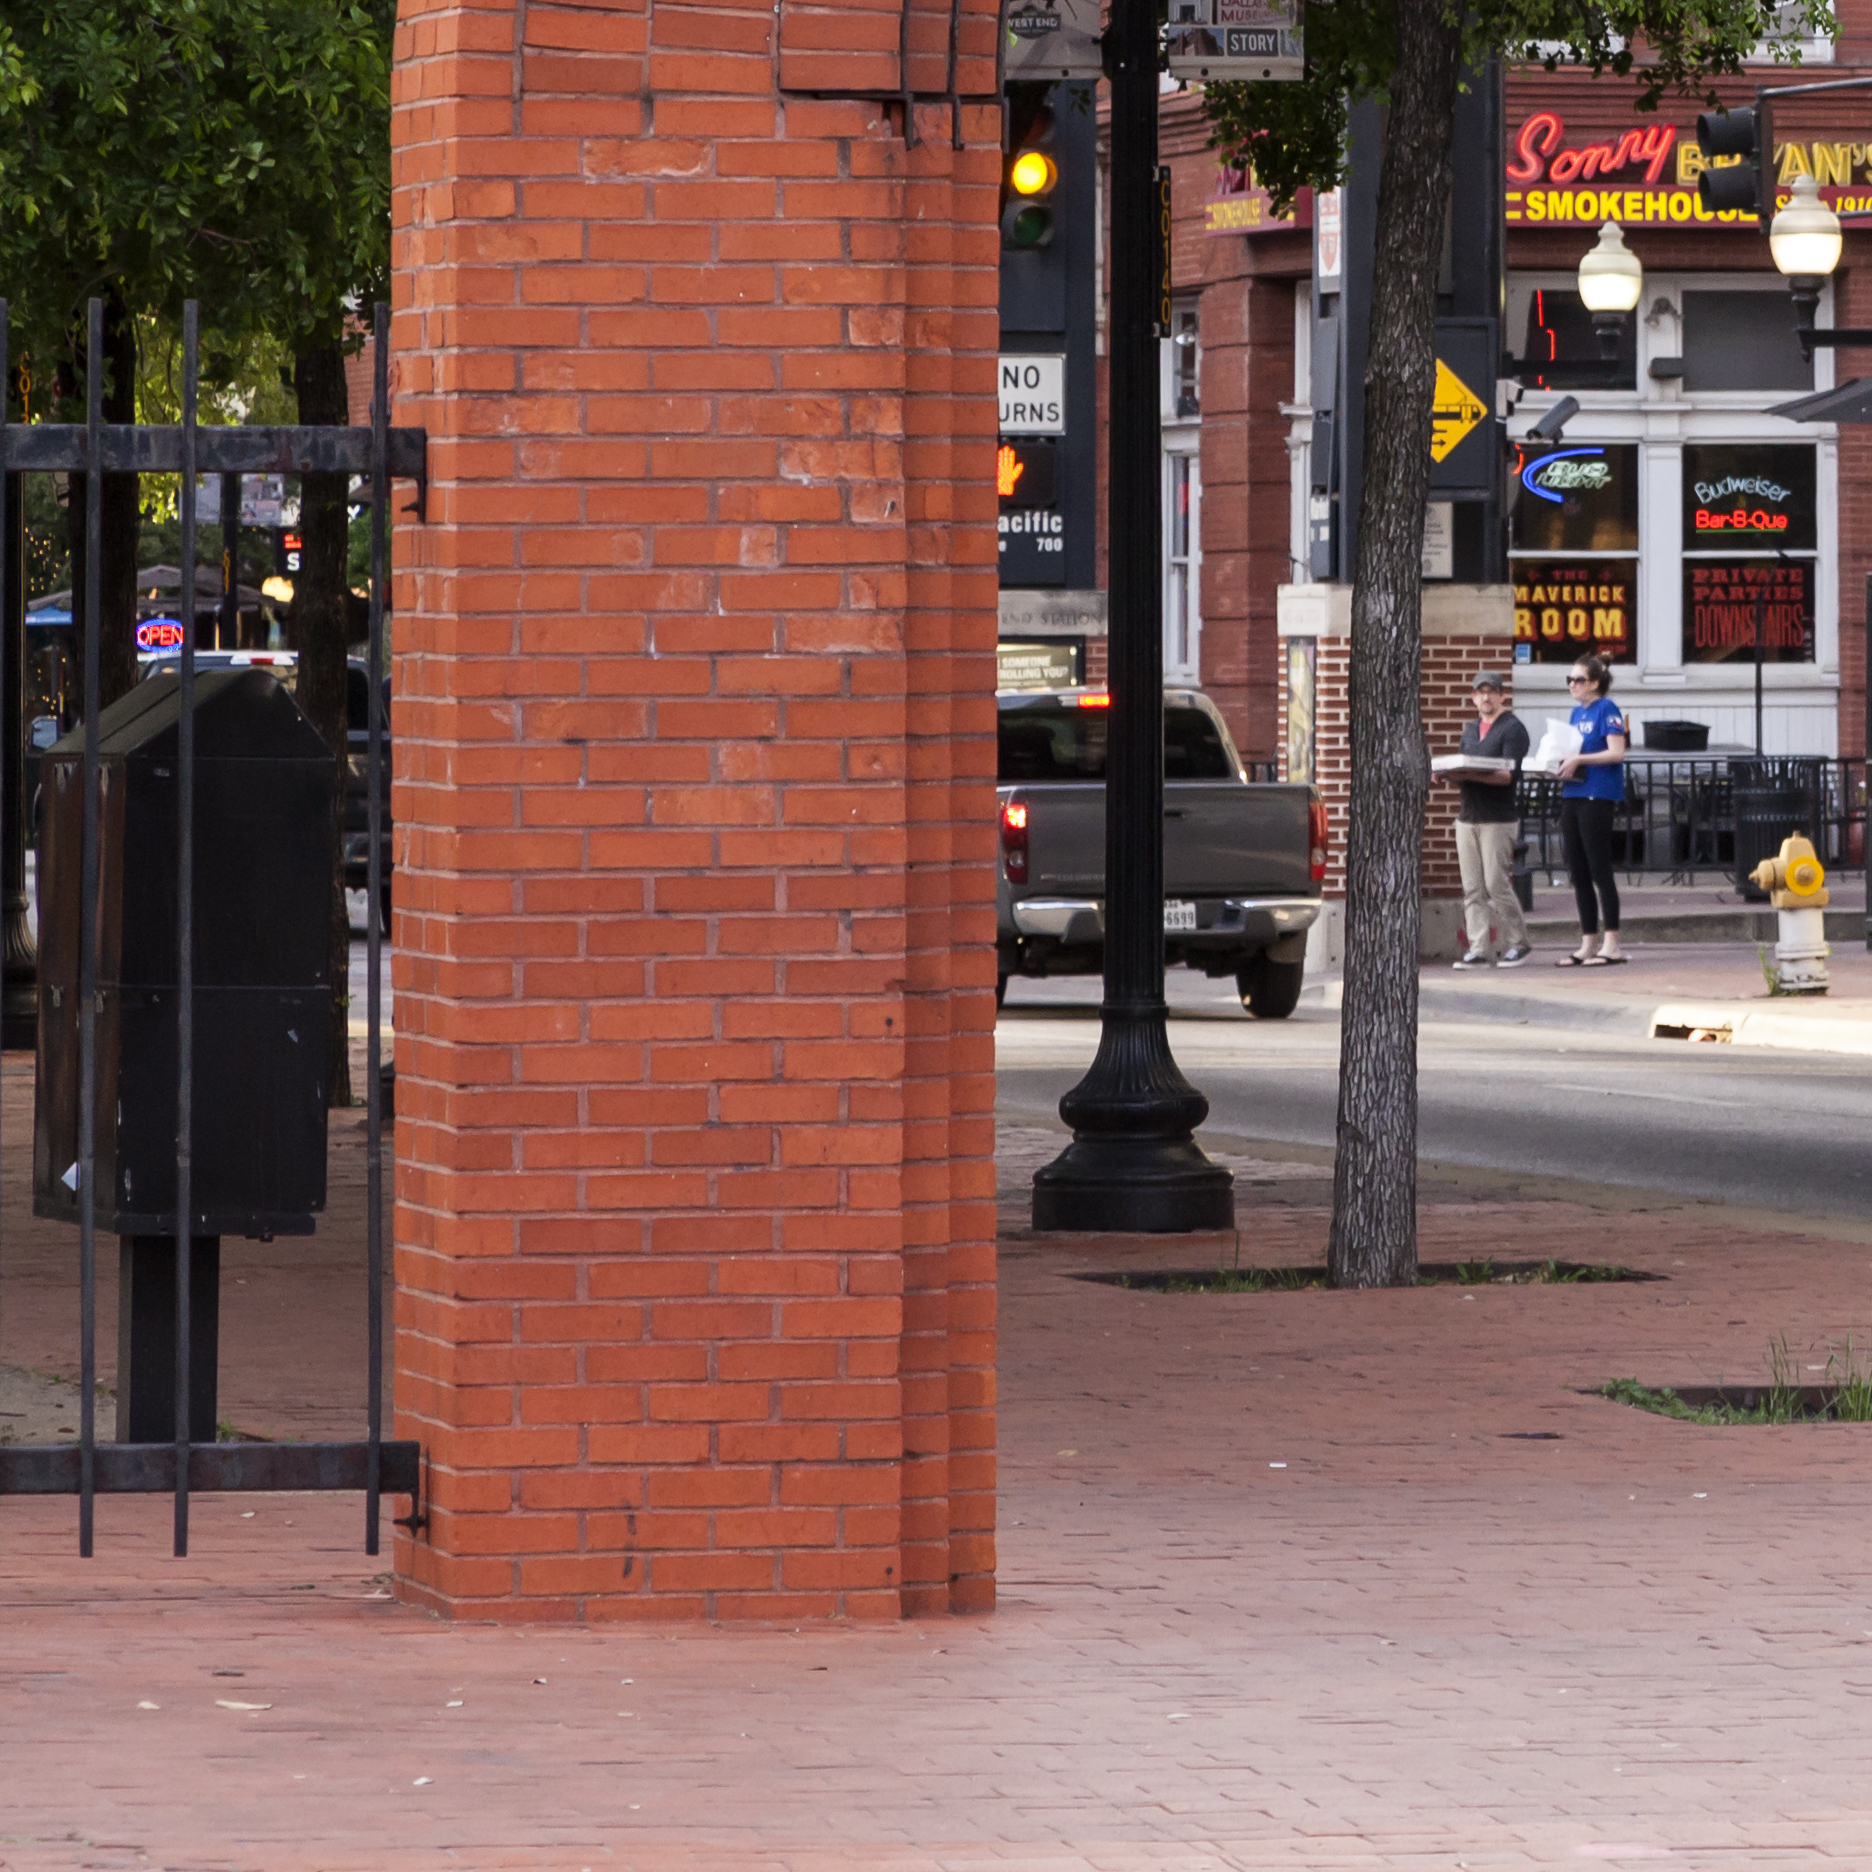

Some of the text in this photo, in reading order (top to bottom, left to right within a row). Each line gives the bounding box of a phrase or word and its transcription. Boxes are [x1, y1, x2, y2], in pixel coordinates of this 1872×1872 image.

[1230, 34, 1276, 52] STORY
[1506, 111, 1676, 185] Sonny
[1002, 365, 1041, 390] NO
[1694, 475, 1792, 504] Budweiser
[1695, 509, 1789, 530] Bar-B-Que
[1036, 537, 1063, 553] 700
[1693, 568, 1804, 584] PRIVATE
[1514, 584, 1626, 605] MAVERICK
[1693, 585, 1804, 602] PARTIES
[137, 624, 184, 646] OPEN
[1514, 607, 1628, 642] ROOM
[1694, 604, 1804, 648] DOWNSAIRS
